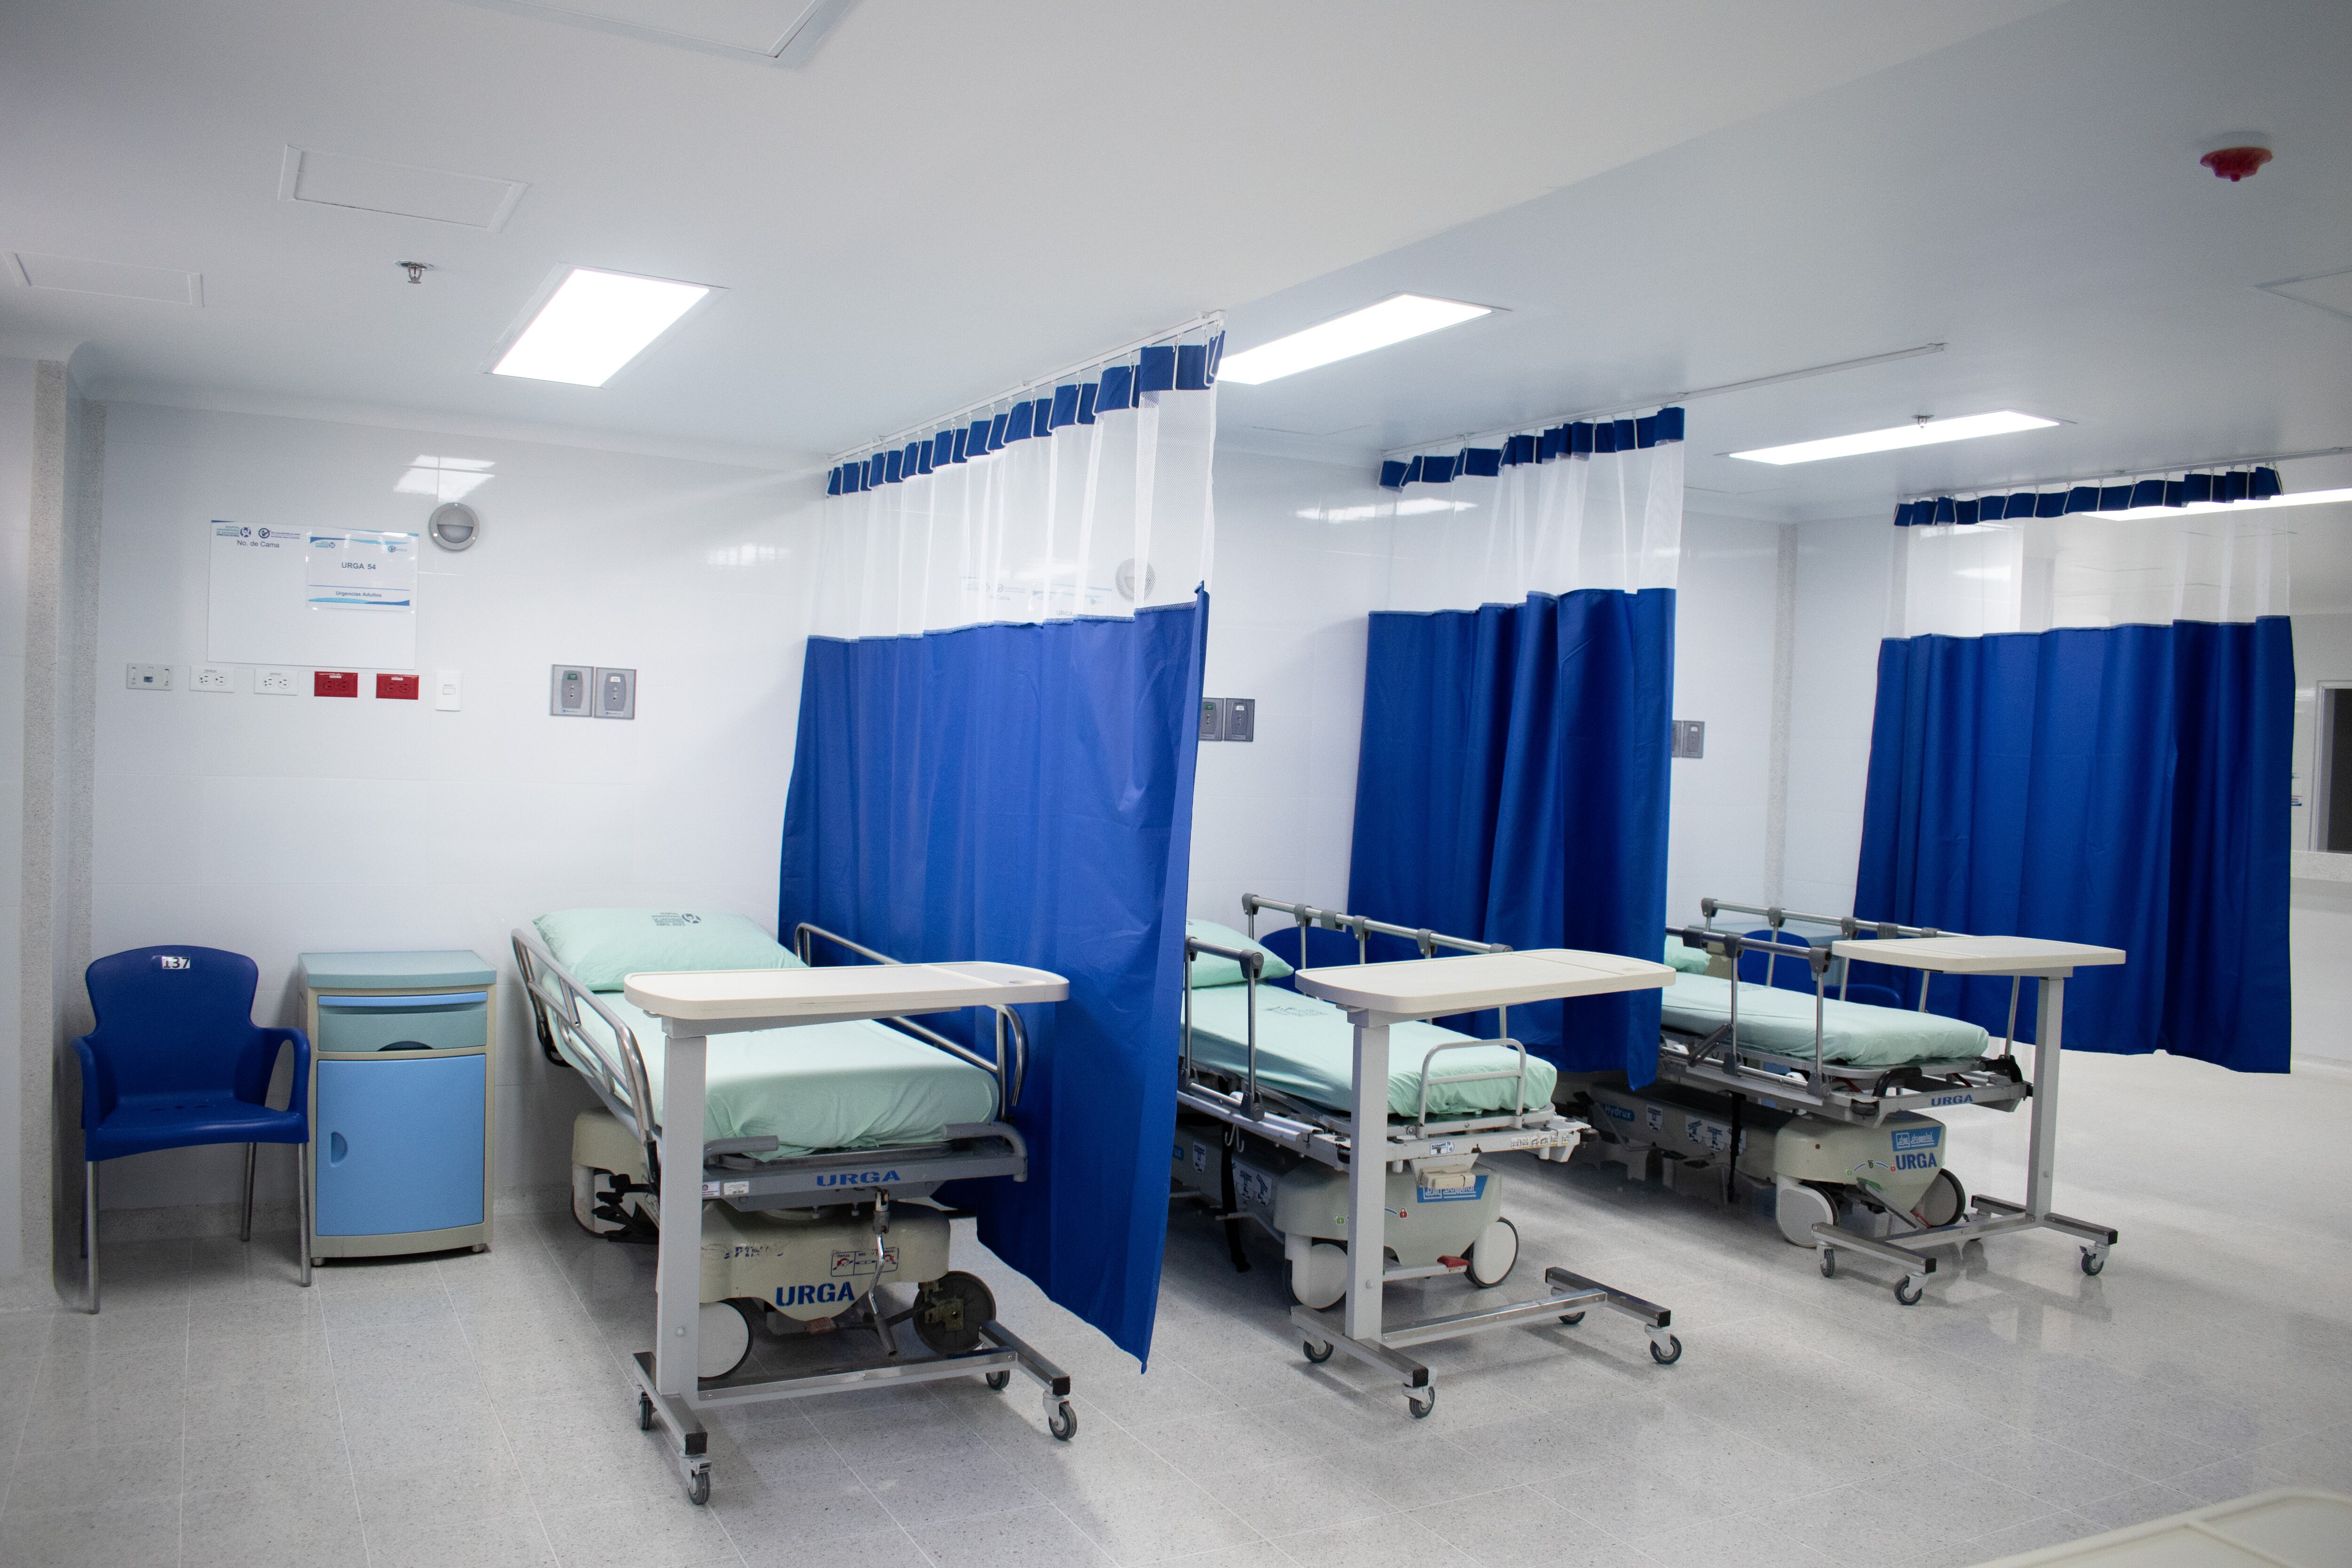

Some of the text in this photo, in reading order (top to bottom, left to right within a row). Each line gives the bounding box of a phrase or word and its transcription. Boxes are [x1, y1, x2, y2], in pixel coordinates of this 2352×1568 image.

[163, 957, 190, 968] 137
[1931, 1094, 1973, 1106] URGA
[1896, 1152, 1937, 1170] URGA
[817, 1170, 900, 1186] URGA
[776, 1281, 855, 1306] URGA
